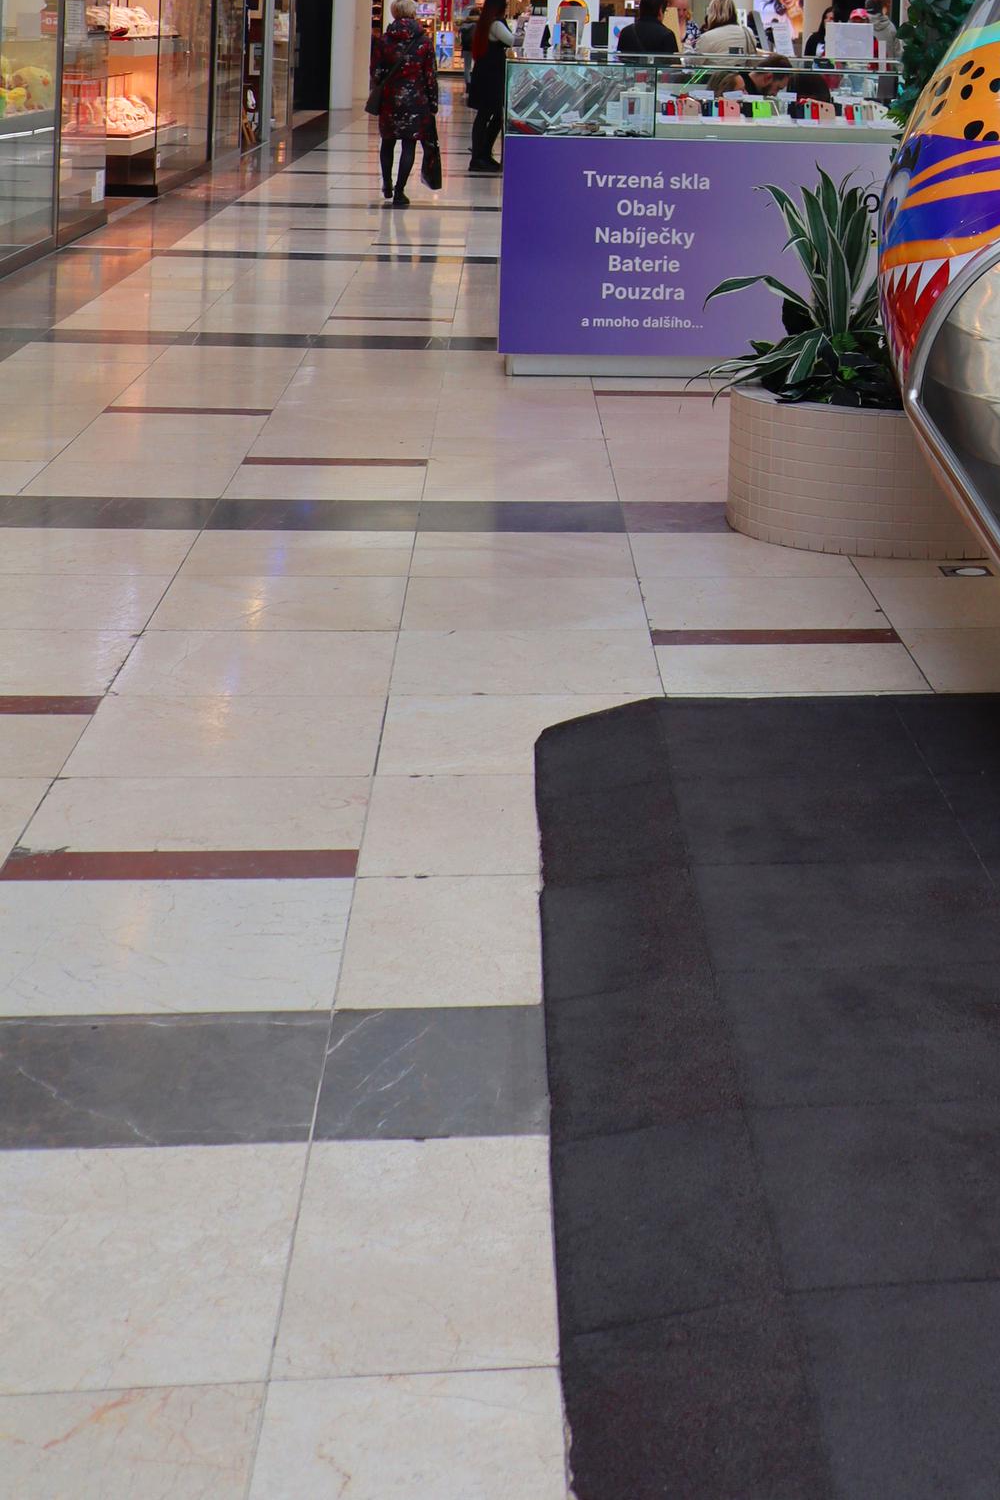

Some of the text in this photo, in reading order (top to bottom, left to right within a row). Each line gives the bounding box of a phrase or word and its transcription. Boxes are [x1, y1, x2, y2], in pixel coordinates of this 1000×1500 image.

[583, 170, 710, 190] Tvrzená skla
[616, 199, 676, 221] Obaly
[595, 226, 695, 249] Nabíječky
[608, 255, 680, 272] Baterie
[601, 282, 685, 300] Pouzdra
[581, 316, 704, 328] a mnoho dalšího...
